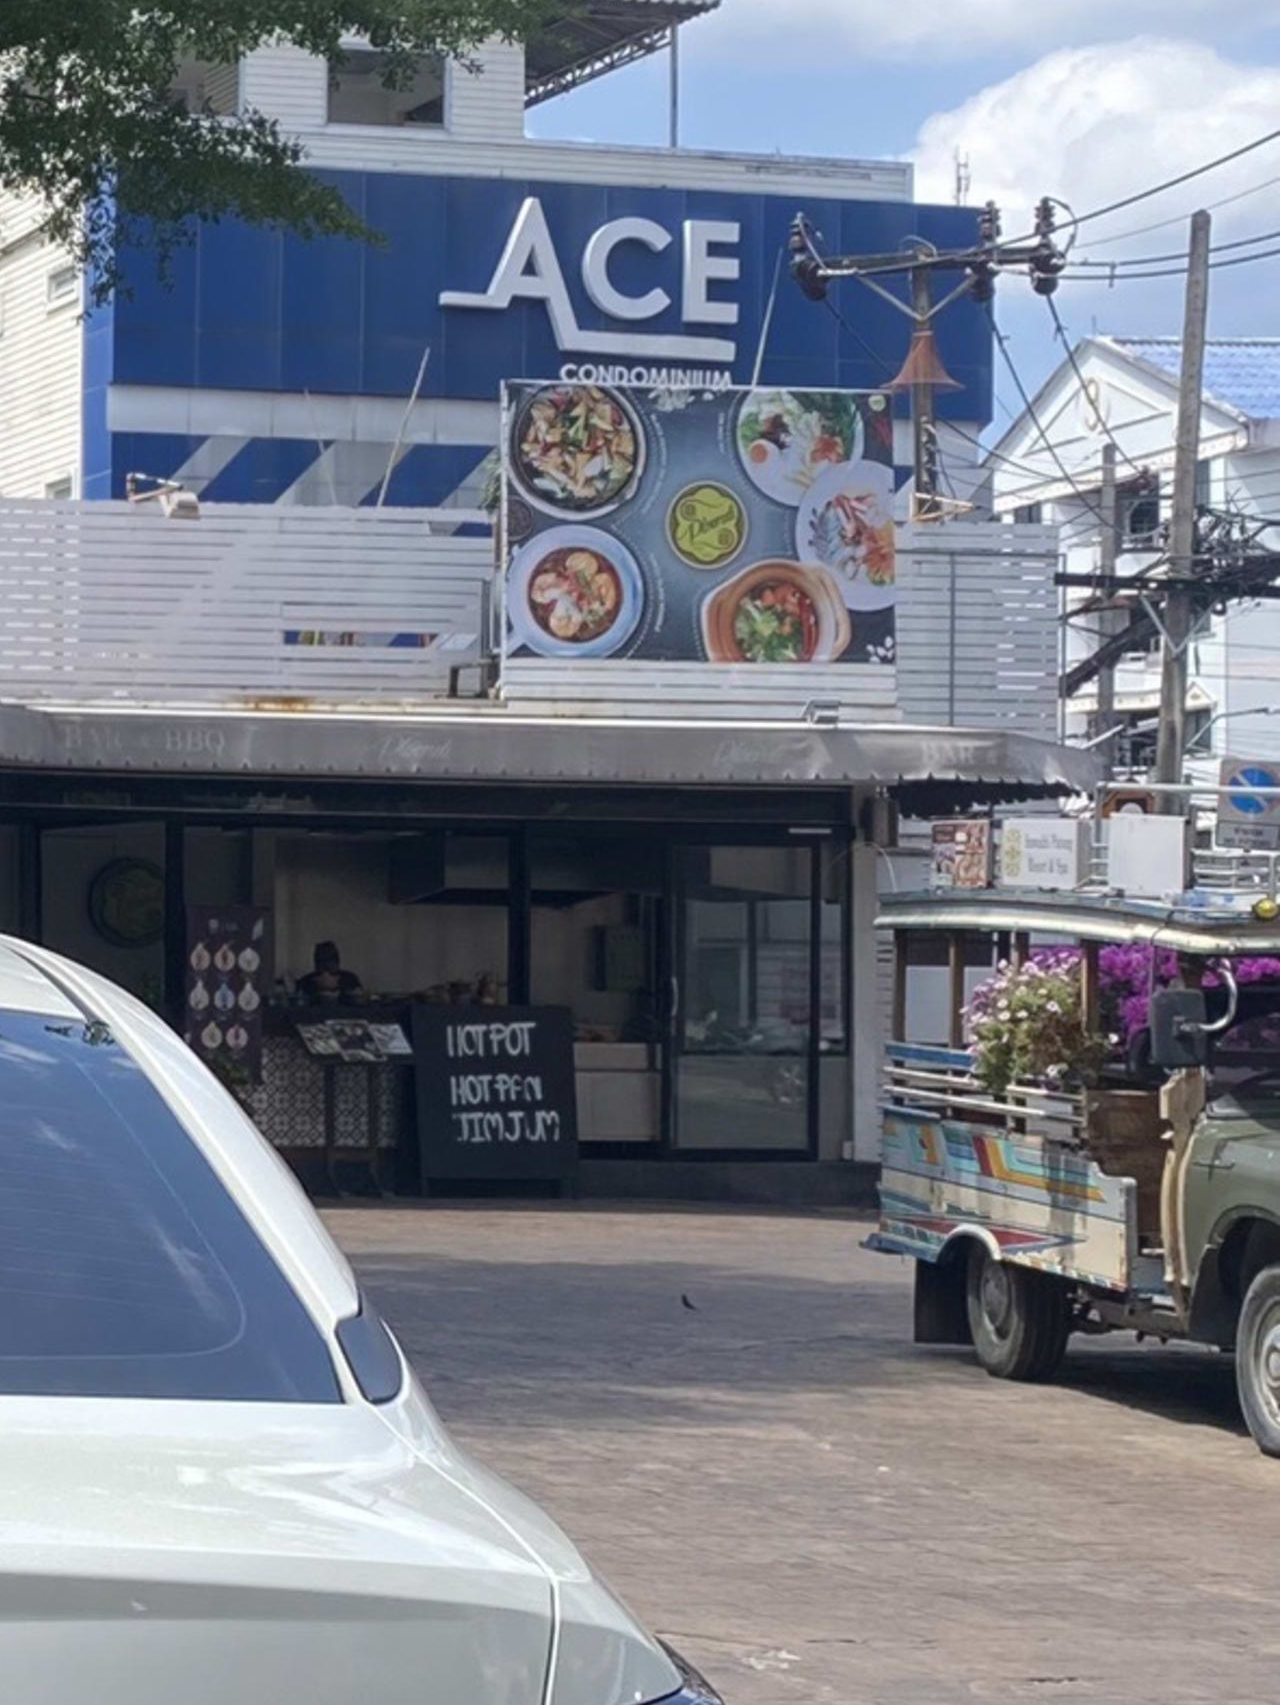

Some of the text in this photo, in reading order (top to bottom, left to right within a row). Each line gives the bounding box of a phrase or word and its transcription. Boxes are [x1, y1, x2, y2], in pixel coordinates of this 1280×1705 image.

[439, 197, 739, 361] ACE
[559, 363, 733, 389] CONDOMINIUM
[166, 729, 225, 756] BBQ
[450, 1075, 493, 1106] HOT
